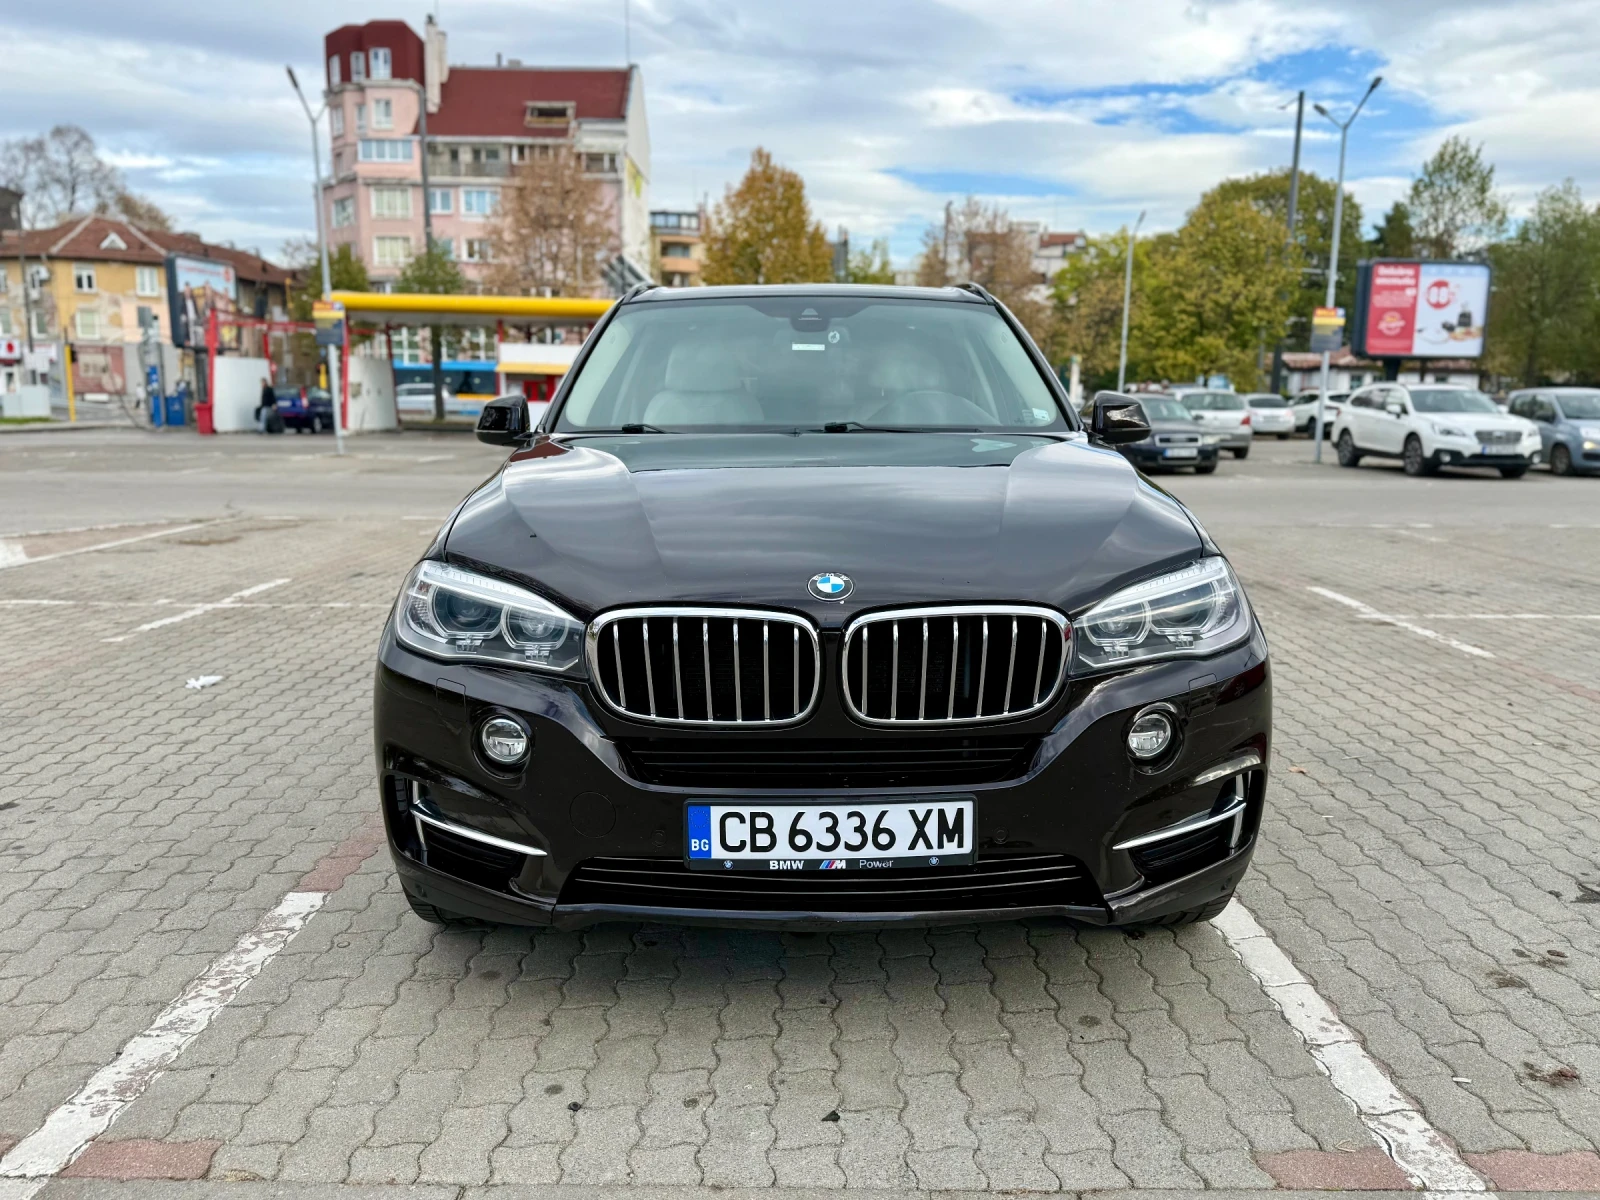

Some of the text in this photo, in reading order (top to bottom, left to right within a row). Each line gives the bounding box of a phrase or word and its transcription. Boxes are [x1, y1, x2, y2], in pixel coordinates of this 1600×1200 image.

[719, 807, 965, 853] CB 6336 XM
[691, 839, 709, 851] BG
[769, 860, 804, 870] BMW
[859, 859, 894, 869] Power
